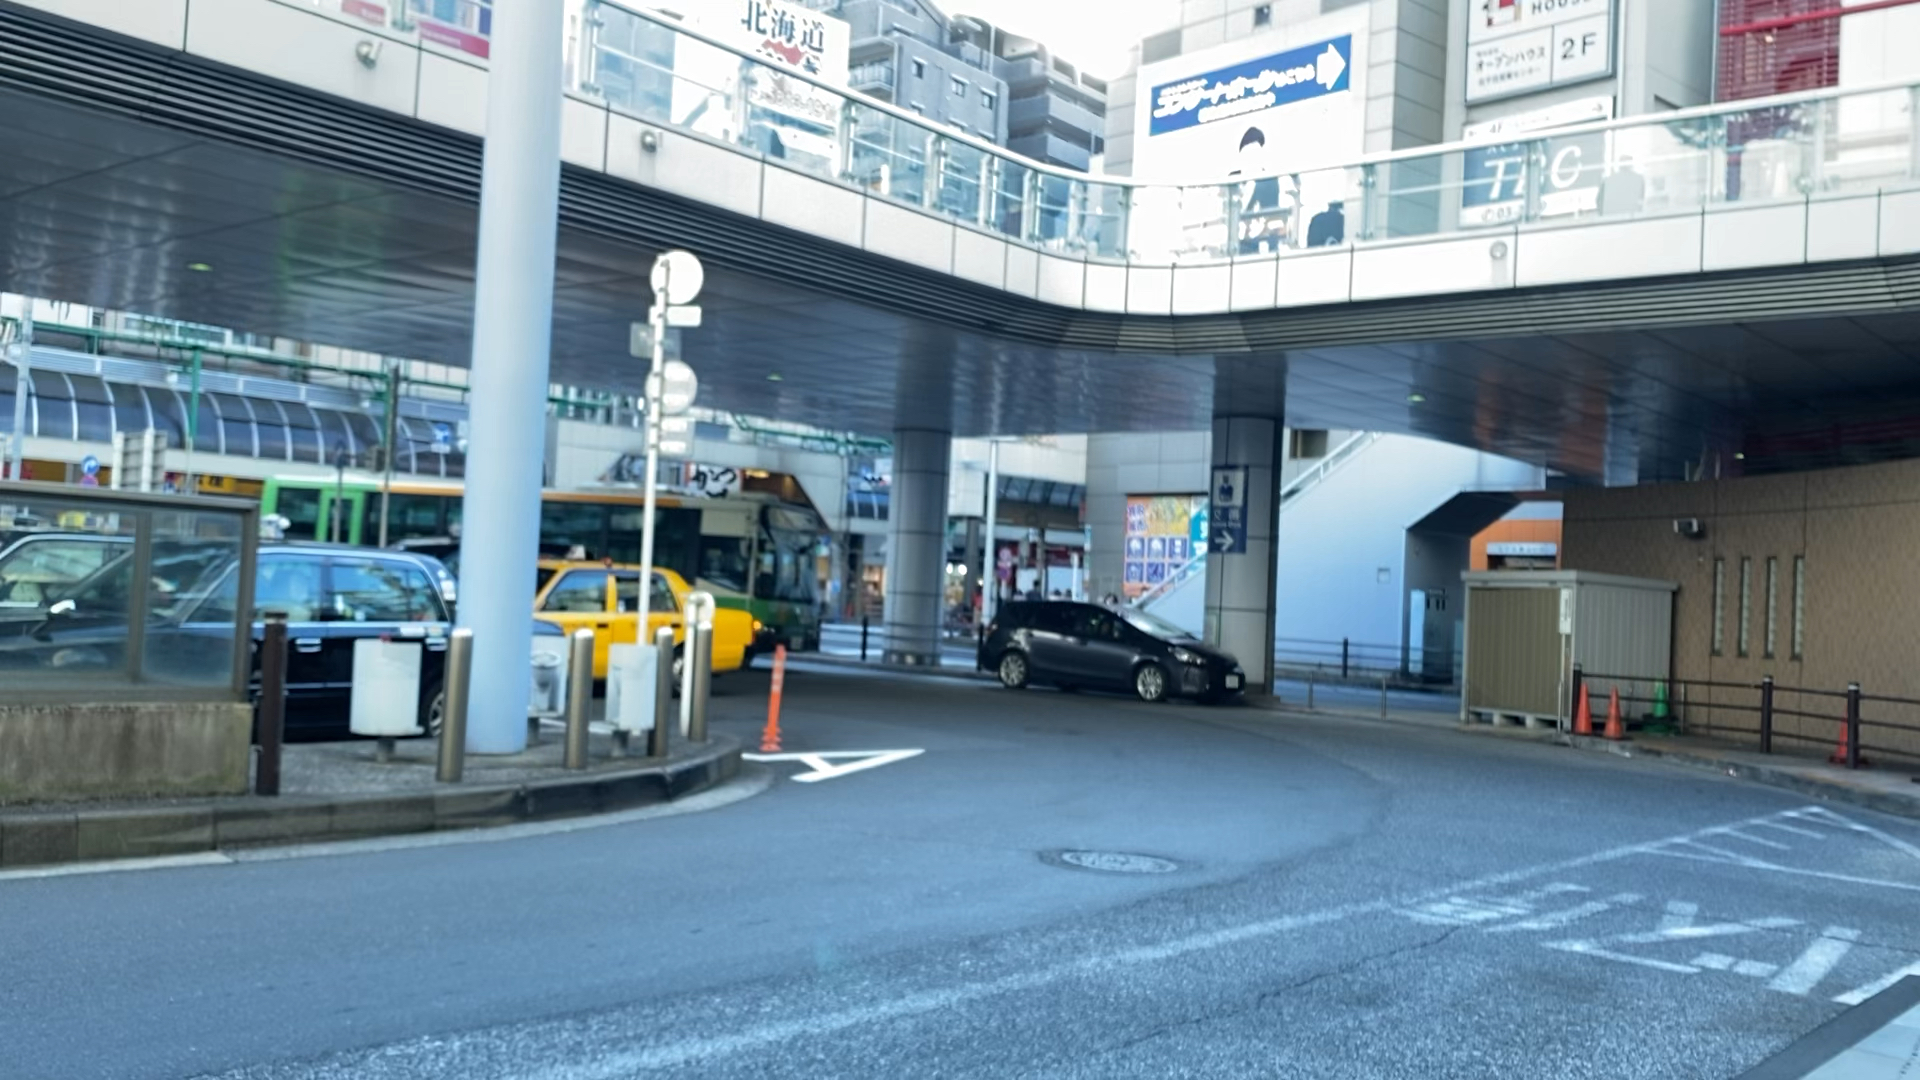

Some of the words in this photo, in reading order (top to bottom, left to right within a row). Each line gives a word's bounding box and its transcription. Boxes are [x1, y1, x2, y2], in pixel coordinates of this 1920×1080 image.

[741, 0, 824, 53] 北海道
[1561, 31, 1597, 60] 2F
